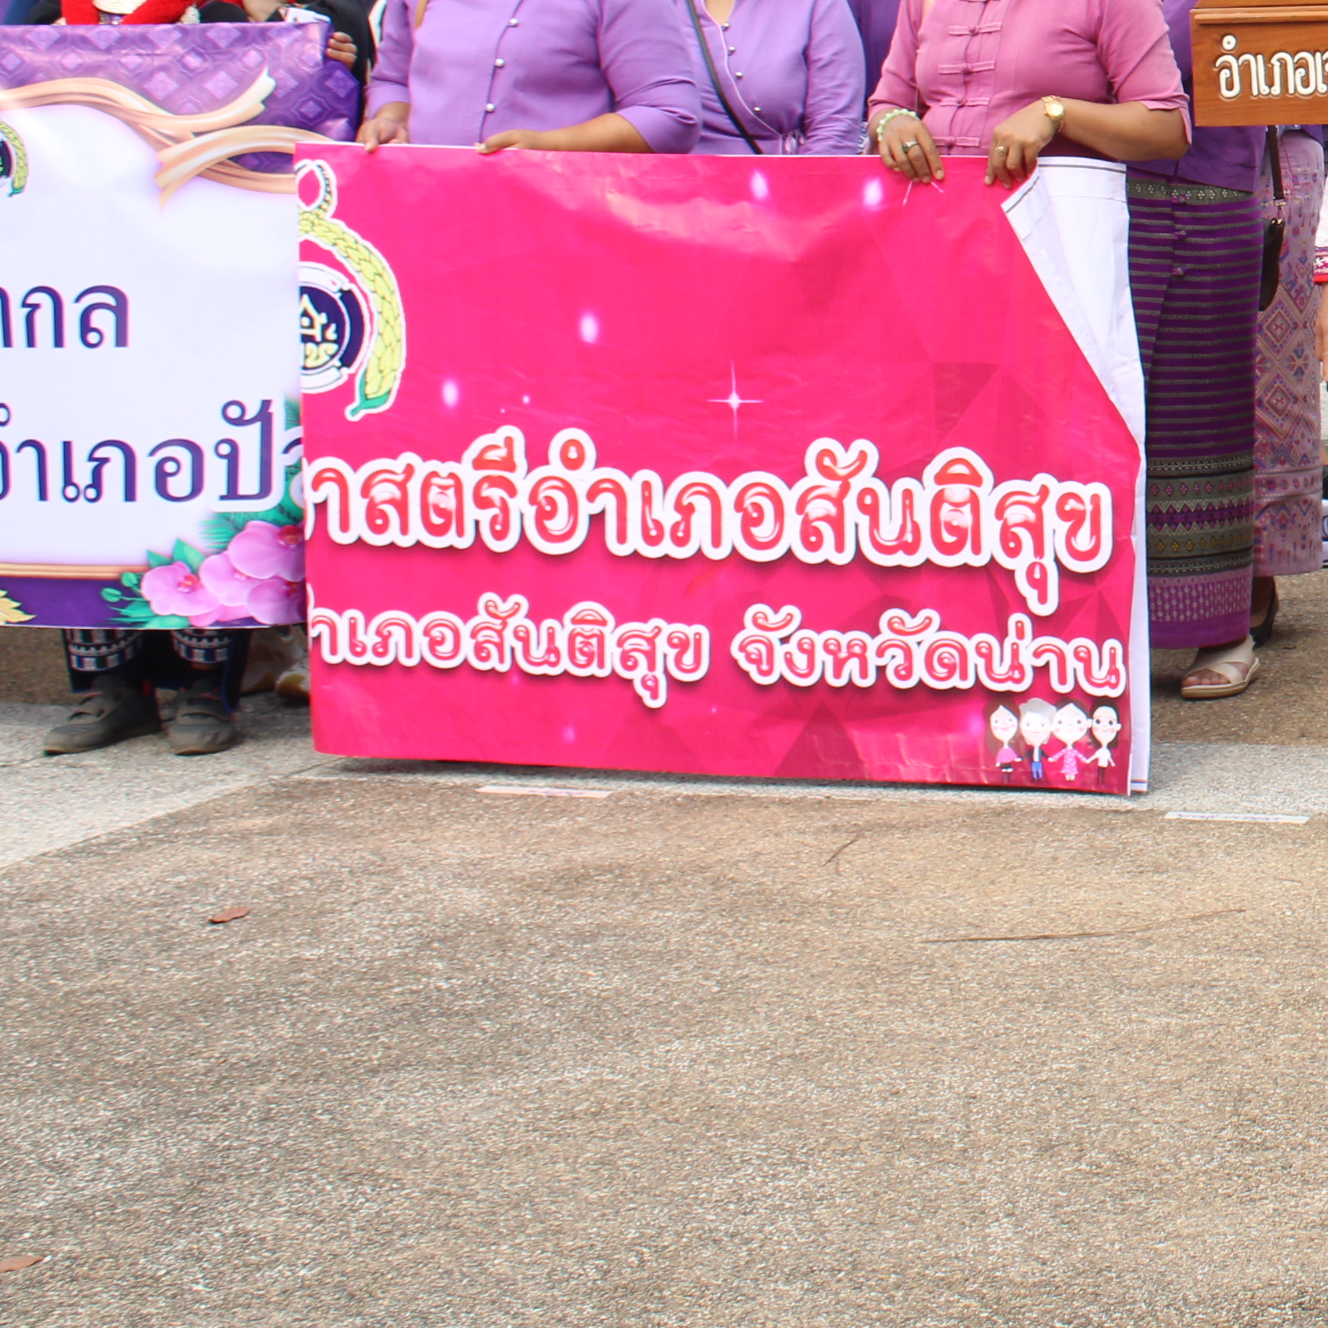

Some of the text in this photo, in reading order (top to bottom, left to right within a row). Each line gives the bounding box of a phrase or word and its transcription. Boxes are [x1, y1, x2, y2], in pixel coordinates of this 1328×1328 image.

[738, 609, 1123, 691] จังหวัดน่าน
